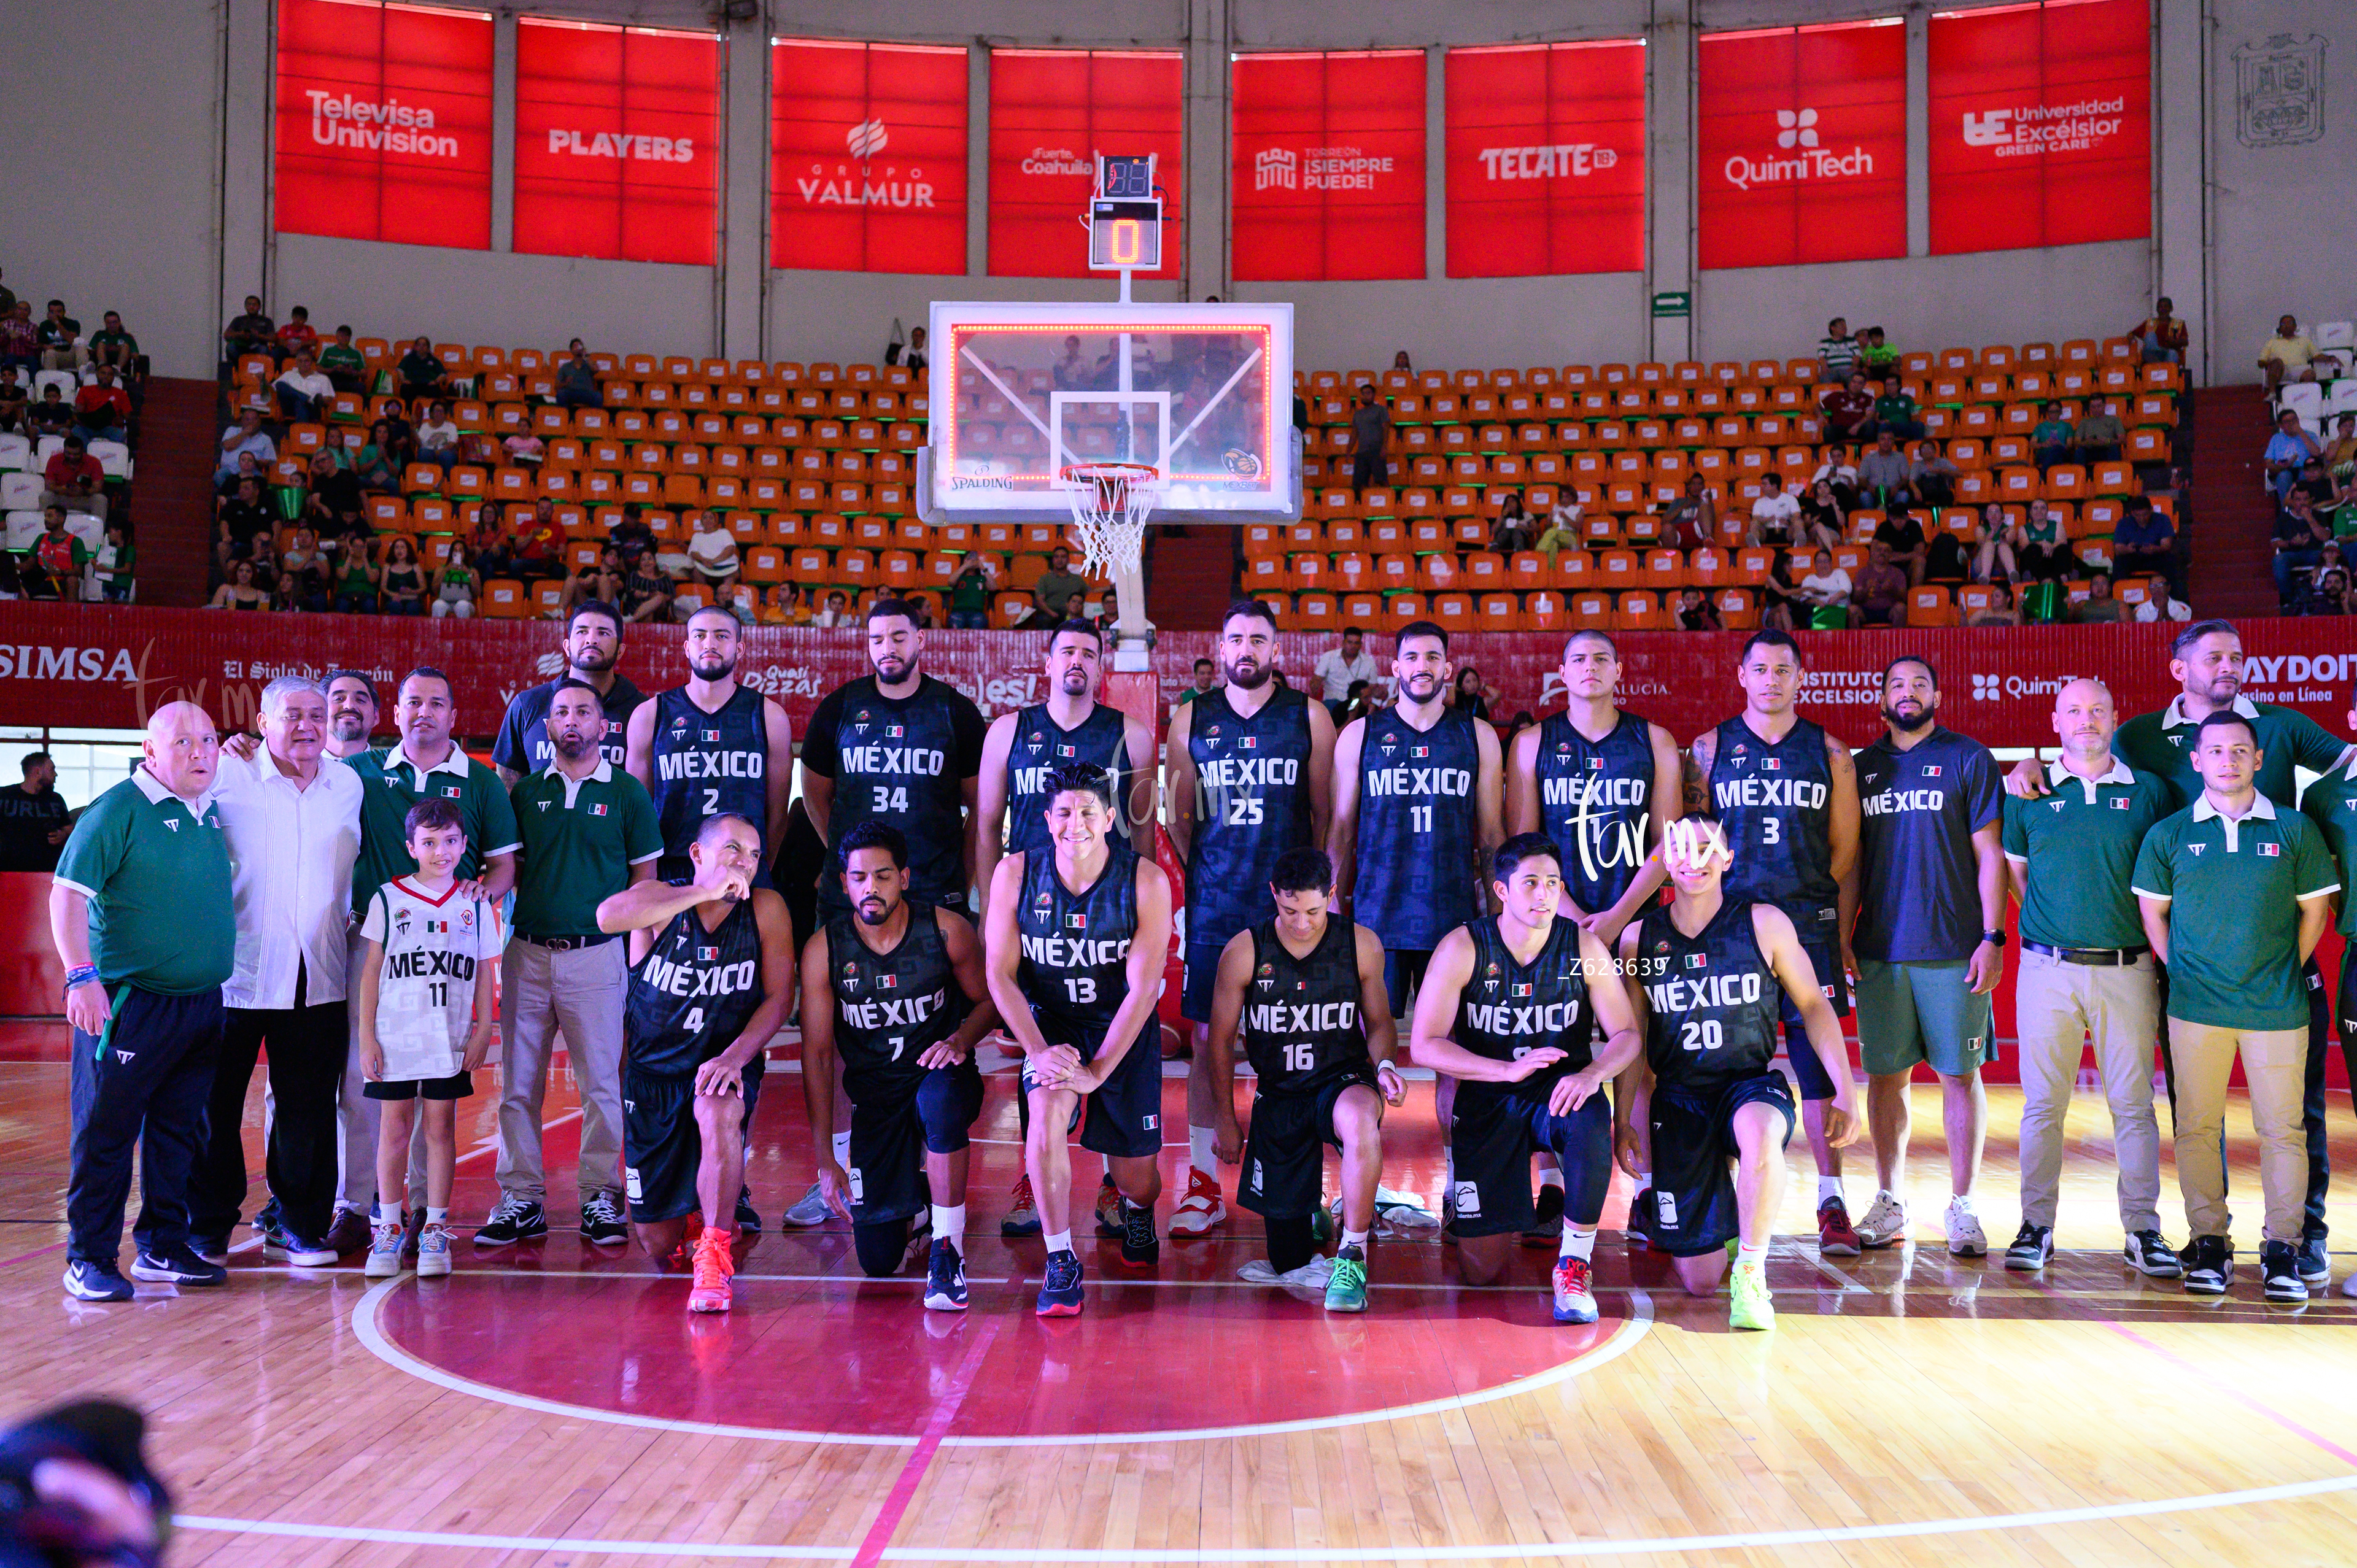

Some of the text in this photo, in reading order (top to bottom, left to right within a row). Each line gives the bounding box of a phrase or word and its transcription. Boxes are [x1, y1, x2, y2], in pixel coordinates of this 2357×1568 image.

[306, 90, 435, 129] Televisa
[2015, 95, 2124, 122] Universidad
[312, 118, 459, 158] Univision
[2015, 117, 2122, 143] Excélsior
[549, 129, 694, 163] PLAYERS
[1995, 137, 2091, 158] GREEN CARE
[1021, 158, 1093, 175] Coahuila
[1478, 144, 1595, 180] TECATE
[797, 179, 935, 208] VALMUR
[1303, 174, 1374, 190] PUEDE!
[1112, 219, 1139, 263] 0
[952, 476, 1013, 490] SPALDING
[0, 644, 139, 682] SIMSA
[223, 660, 244, 679] El
[303, 662, 321, 681] de
[2242, 686, 2332, 702] asino en Línea
[536, 741, 624, 765] MCO
[659, 746, 762, 781] MÉXICO
[843, 741, 944, 776] MÉXICO
[1199, 753, 1298, 788] MÉXICO
[1368, 762, 1471, 797] MÉXICO
[703, 789, 719, 814] 2
[872, 787, 908, 813] 34
[1544, 772, 1646, 806] MÉXICO
[1716, 773, 1827, 809] MÉXICO
[1862, 787, 1943, 817] MÉXICO
[0, 799, 60, 817] URLE
[1229, 799, 1263, 825] 25
[1411, 806, 1431, 833] 11
[1763, 817, 1780, 844] 3
[389, 945, 475, 981] MÉXICO
[643, 955, 755, 997] MÉXICO
[429, 983, 447, 1006] 11
[1064, 978, 1097, 1003] 13
[1643, 972, 1760, 1014] MÉXICO
[683, 1008, 705, 1033] 4
[839, 987, 945, 1030] MÉXICO
[1249, 999, 1355, 1033] MÉXICO
[1467, 999, 1579, 1035] MÉXICO
[1682, 1019, 1723, 1050] 20
[889, 1037, 904, 1062] 7
[1283, 1043, 1314, 1071] 16
